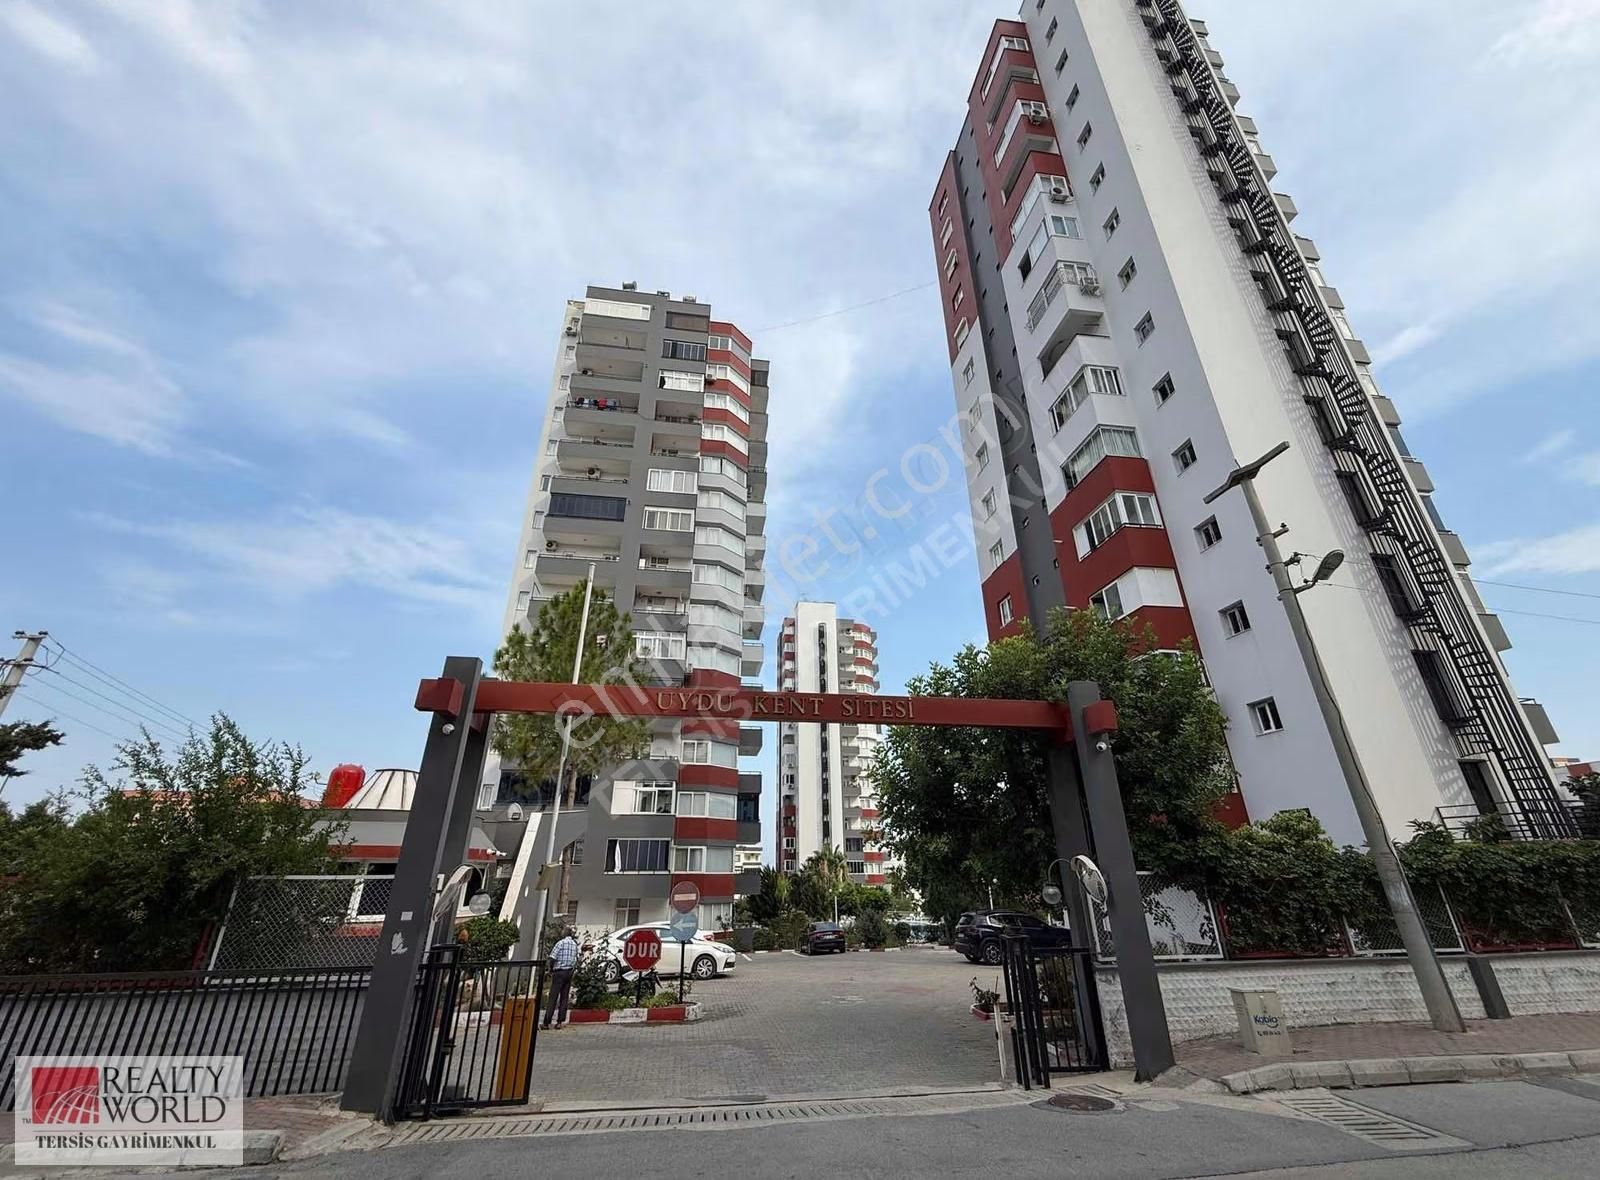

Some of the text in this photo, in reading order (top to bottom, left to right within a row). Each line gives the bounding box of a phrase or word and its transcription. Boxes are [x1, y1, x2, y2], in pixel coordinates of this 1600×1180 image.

[657, 692, 916, 719] UYDU KENT SİTESİ
[626, 943, 658, 958] DUR
